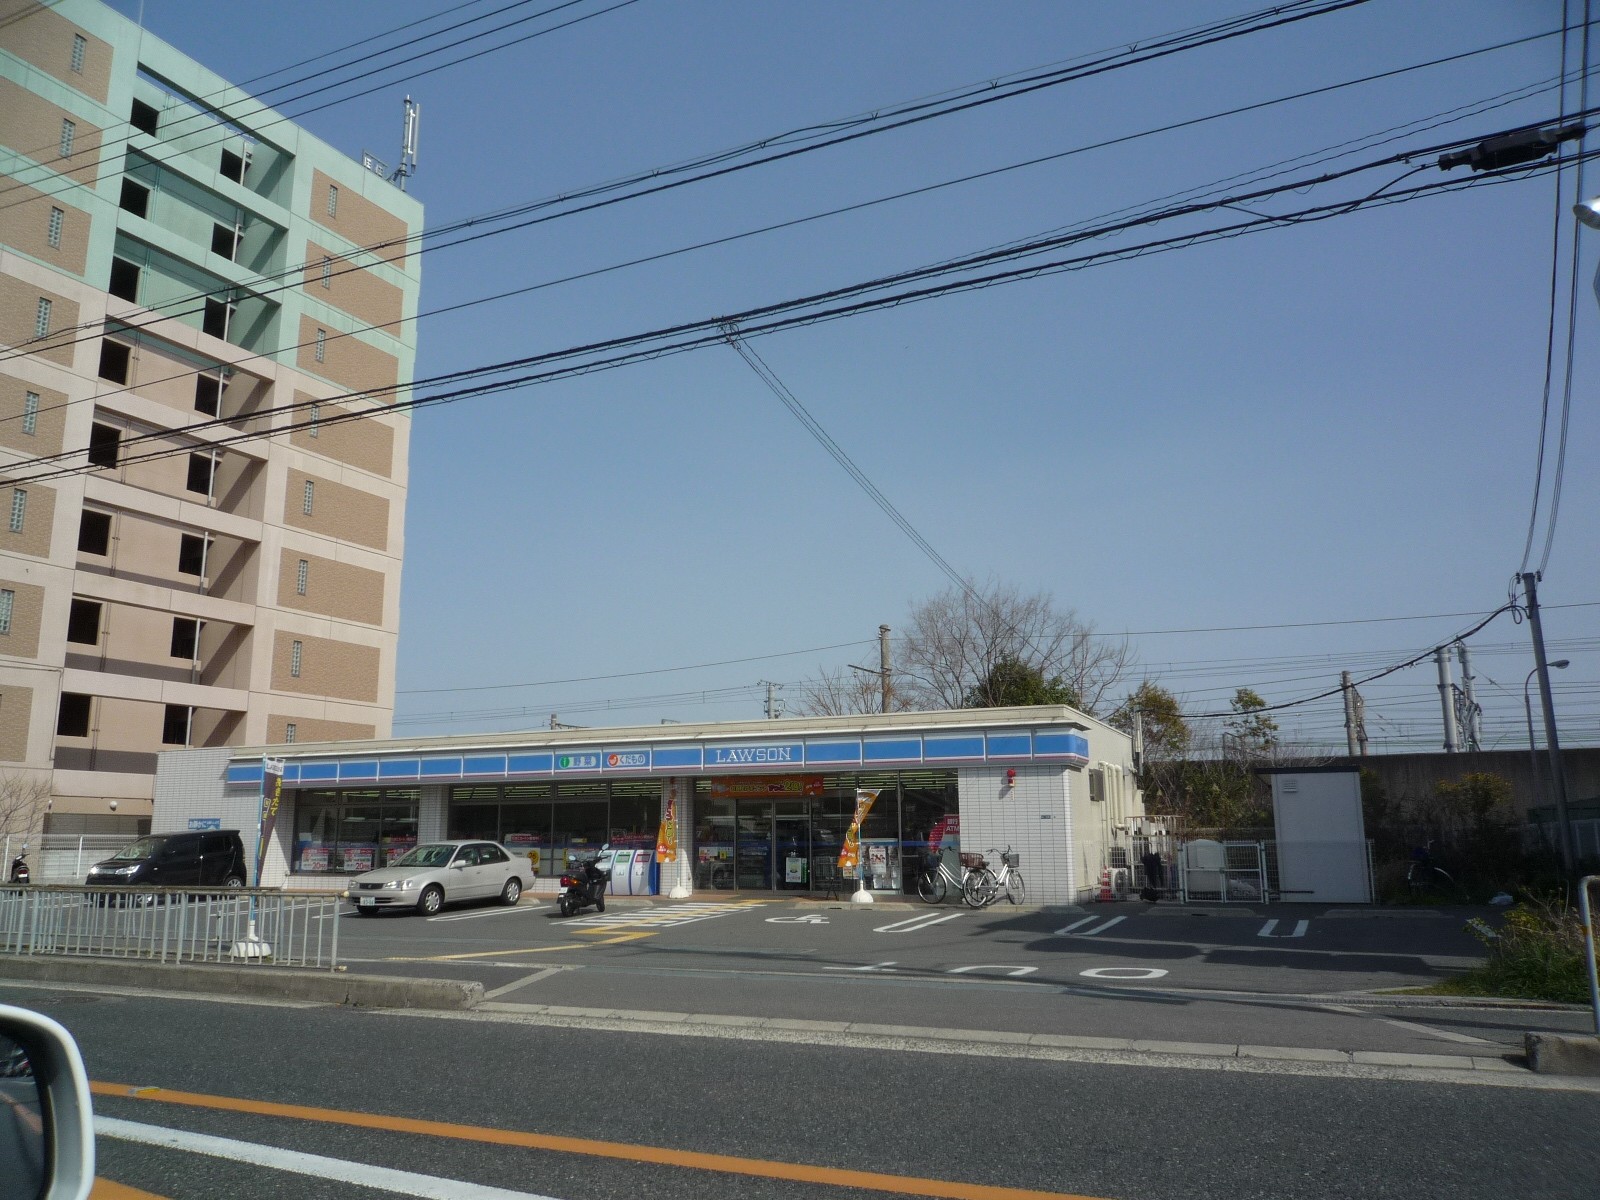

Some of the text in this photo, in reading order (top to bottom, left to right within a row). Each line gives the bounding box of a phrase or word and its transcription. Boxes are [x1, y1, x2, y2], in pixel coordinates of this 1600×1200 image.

[619, 754, 644, 765] くだもの
[716, 747, 791, 763] LAWSON
